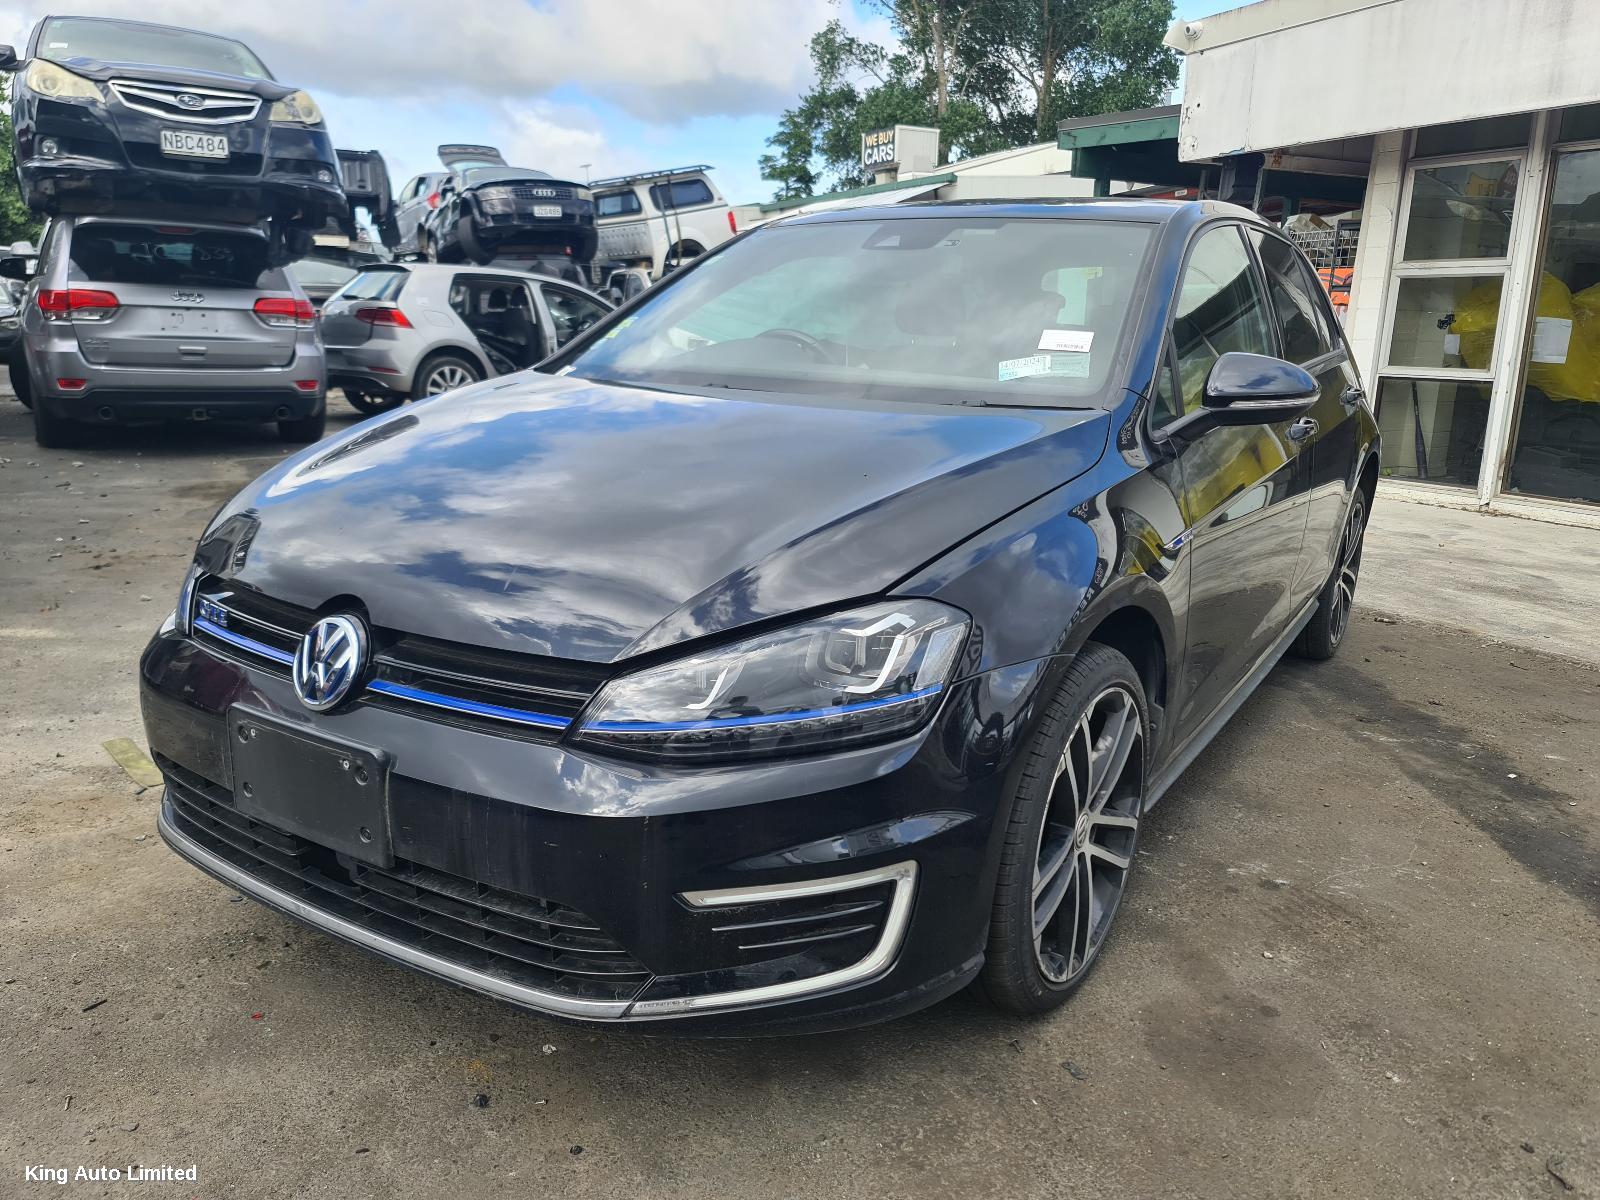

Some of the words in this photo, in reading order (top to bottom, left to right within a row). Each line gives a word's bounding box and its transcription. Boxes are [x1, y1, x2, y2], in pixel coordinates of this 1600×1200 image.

[163, 132, 226, 153] NBC484
[866, 134, 878, 147] WE
[878, 130, 894, 145] BUY
[864, 143, 894, 165] CARS
